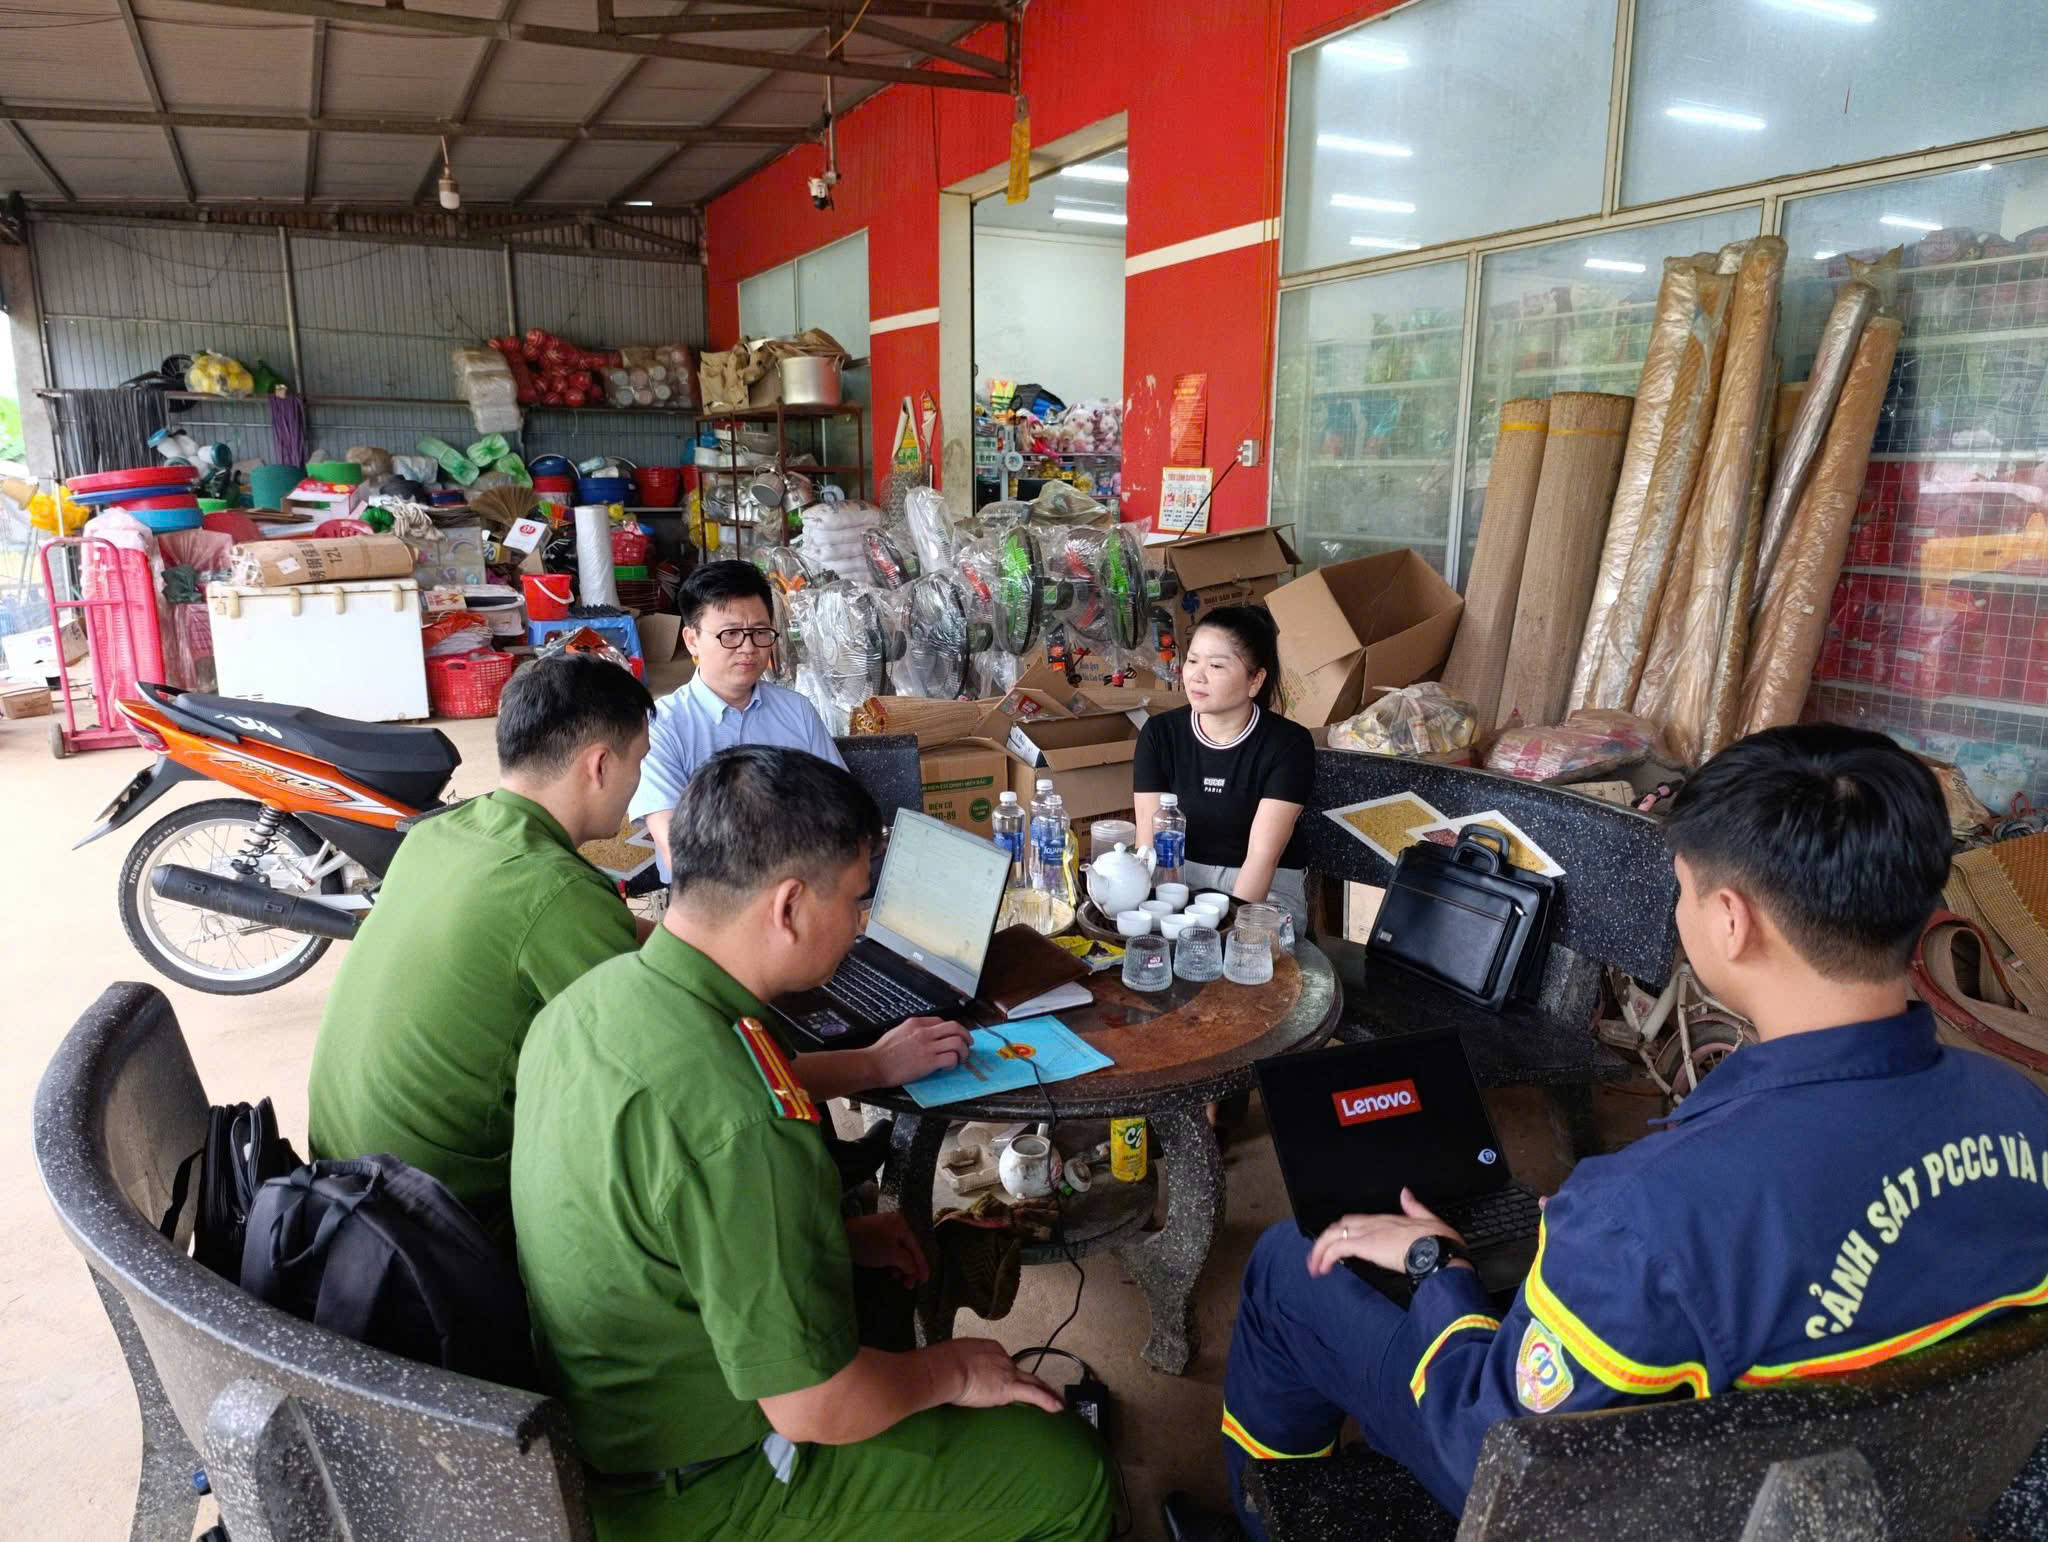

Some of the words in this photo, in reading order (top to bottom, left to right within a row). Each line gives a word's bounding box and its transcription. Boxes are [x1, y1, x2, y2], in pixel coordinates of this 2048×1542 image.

[1340, 1090, 1413, 1118] Lenovo
[1804, 1228, 1880, 1340] CẢNH
[1866, 1166, 1921, 1244] SÁT
[1921, 1133, 1999, 1198] PCCC
[1998, 1130, 2038, 1184] VÀ
